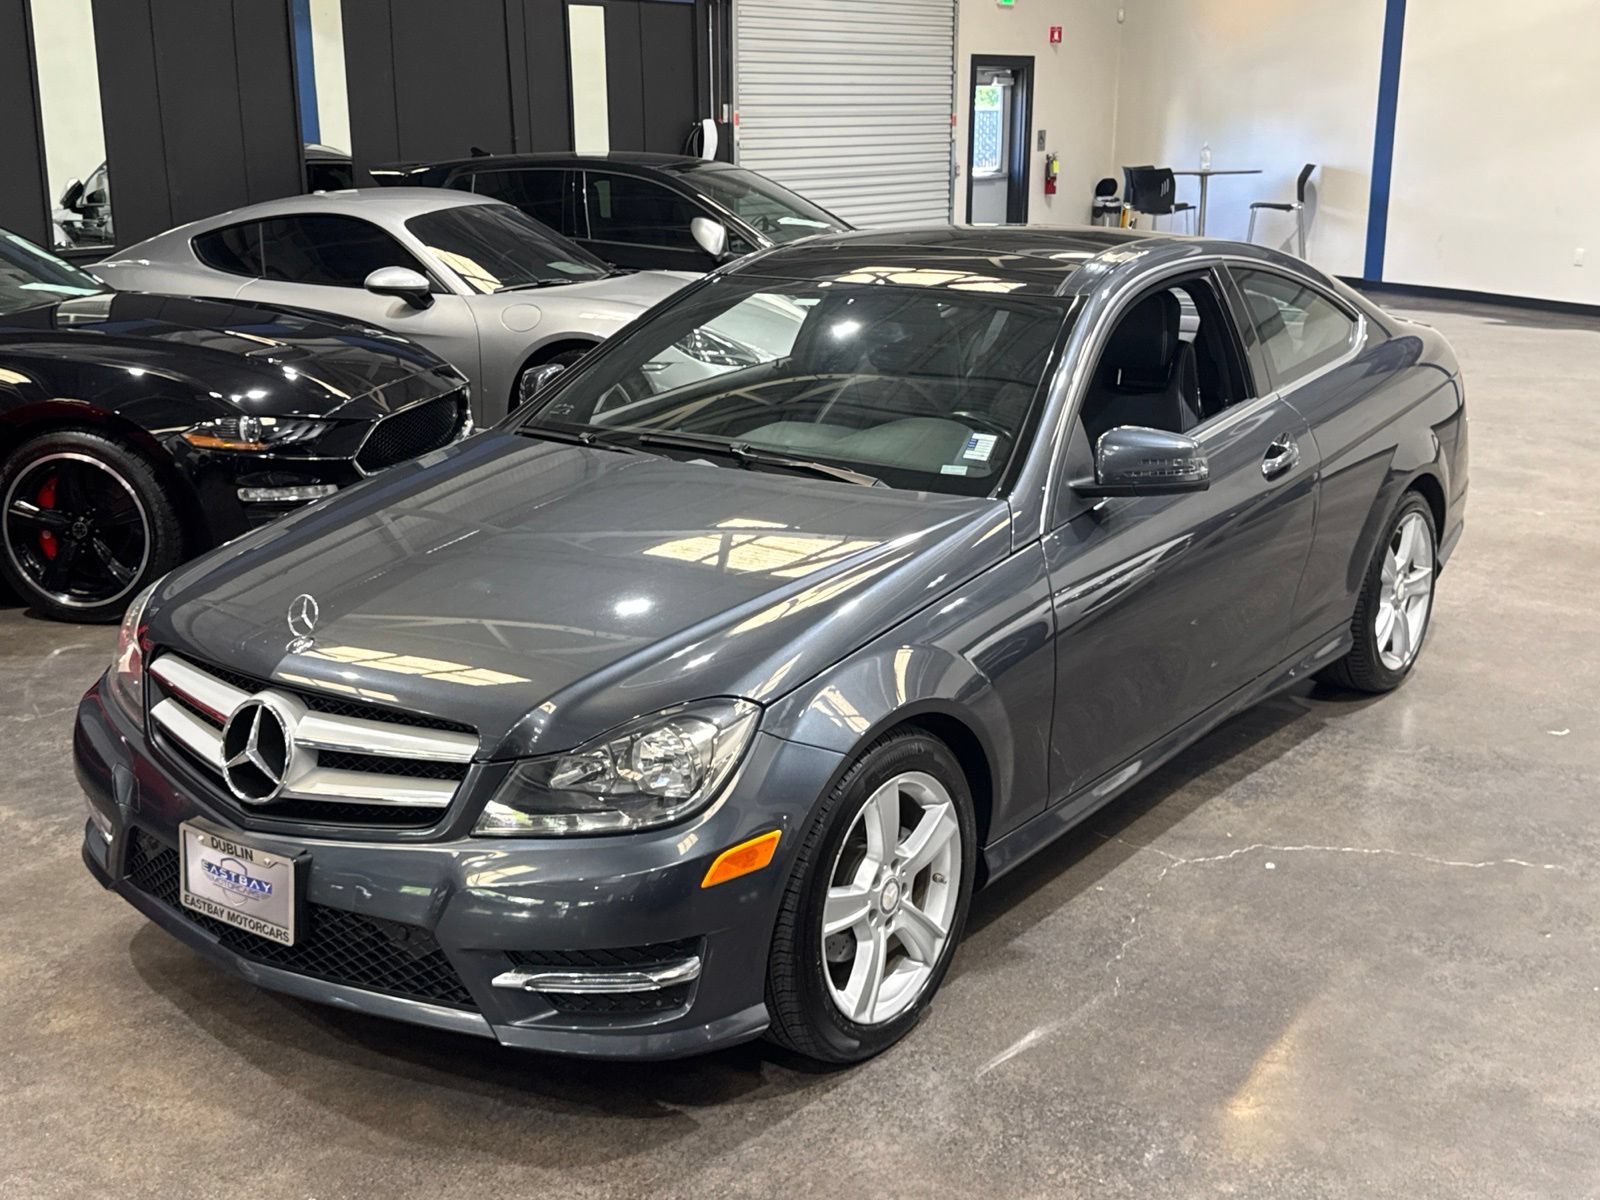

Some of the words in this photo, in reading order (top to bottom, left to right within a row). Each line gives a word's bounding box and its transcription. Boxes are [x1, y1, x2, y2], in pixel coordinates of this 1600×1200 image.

[210, 836, 254, 861] DUBLIN
[201, 859, 271, 894] EASTBAY
[184, 894, 225, 919] EASTBAY
[226, 911, 290, 942] MOTORCARS
